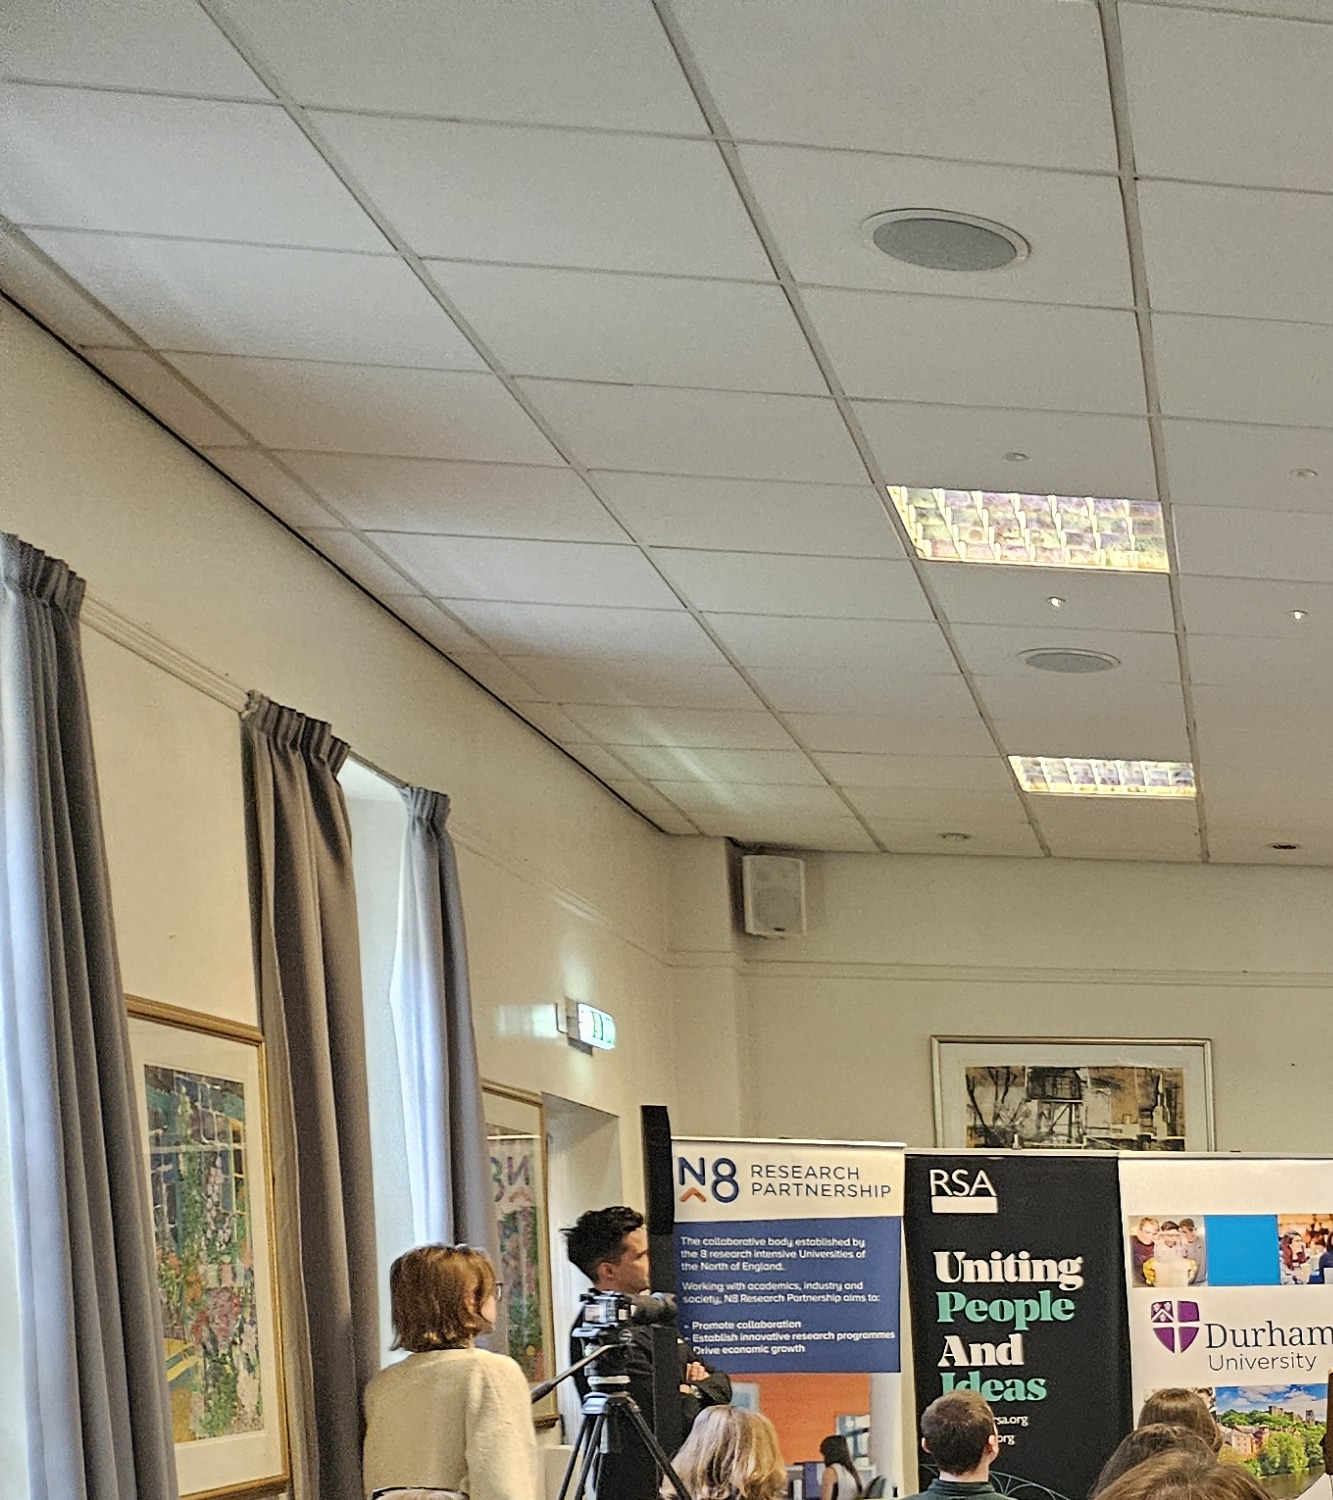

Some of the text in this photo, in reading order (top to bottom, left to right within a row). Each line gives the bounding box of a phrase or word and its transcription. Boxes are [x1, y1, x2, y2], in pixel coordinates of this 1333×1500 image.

[678, 1157, 860, 1204] N8 RESEARCH
[929, 1169, 997, 1197] RSA
[751, 1182, 892, 1198] PARTNERSHIP
[681, 1236, 866, 1248] The collaborative body established by
[681, 1249, 866, 1259] the 8 research intensive Universities of
[681, 1261, 785, 1273] the North of England.
[932, 1250, 1085, 1291] Uniting
[682, 1280, 864, 1293] Working with academics, industry and
[740, 1293, 785, 1303] Research
[787, 1293, 841, 1304] Partnership
[843, 1293, 866, 1302] aims
[867, 1293, 880, 1302] to:
[935, 1289, 1076, 1331] People
[692, 1320, 802, 1331] Promote collaboration
[692, 1331, 895, 1343] Establish innovative research programmes
[722, 1345, 769, 1354] economic
[771, 1344, 806, 1355] growth
[937, 1333, 1025, 1367] And
[1208, 1351, 1318, 1372] University
